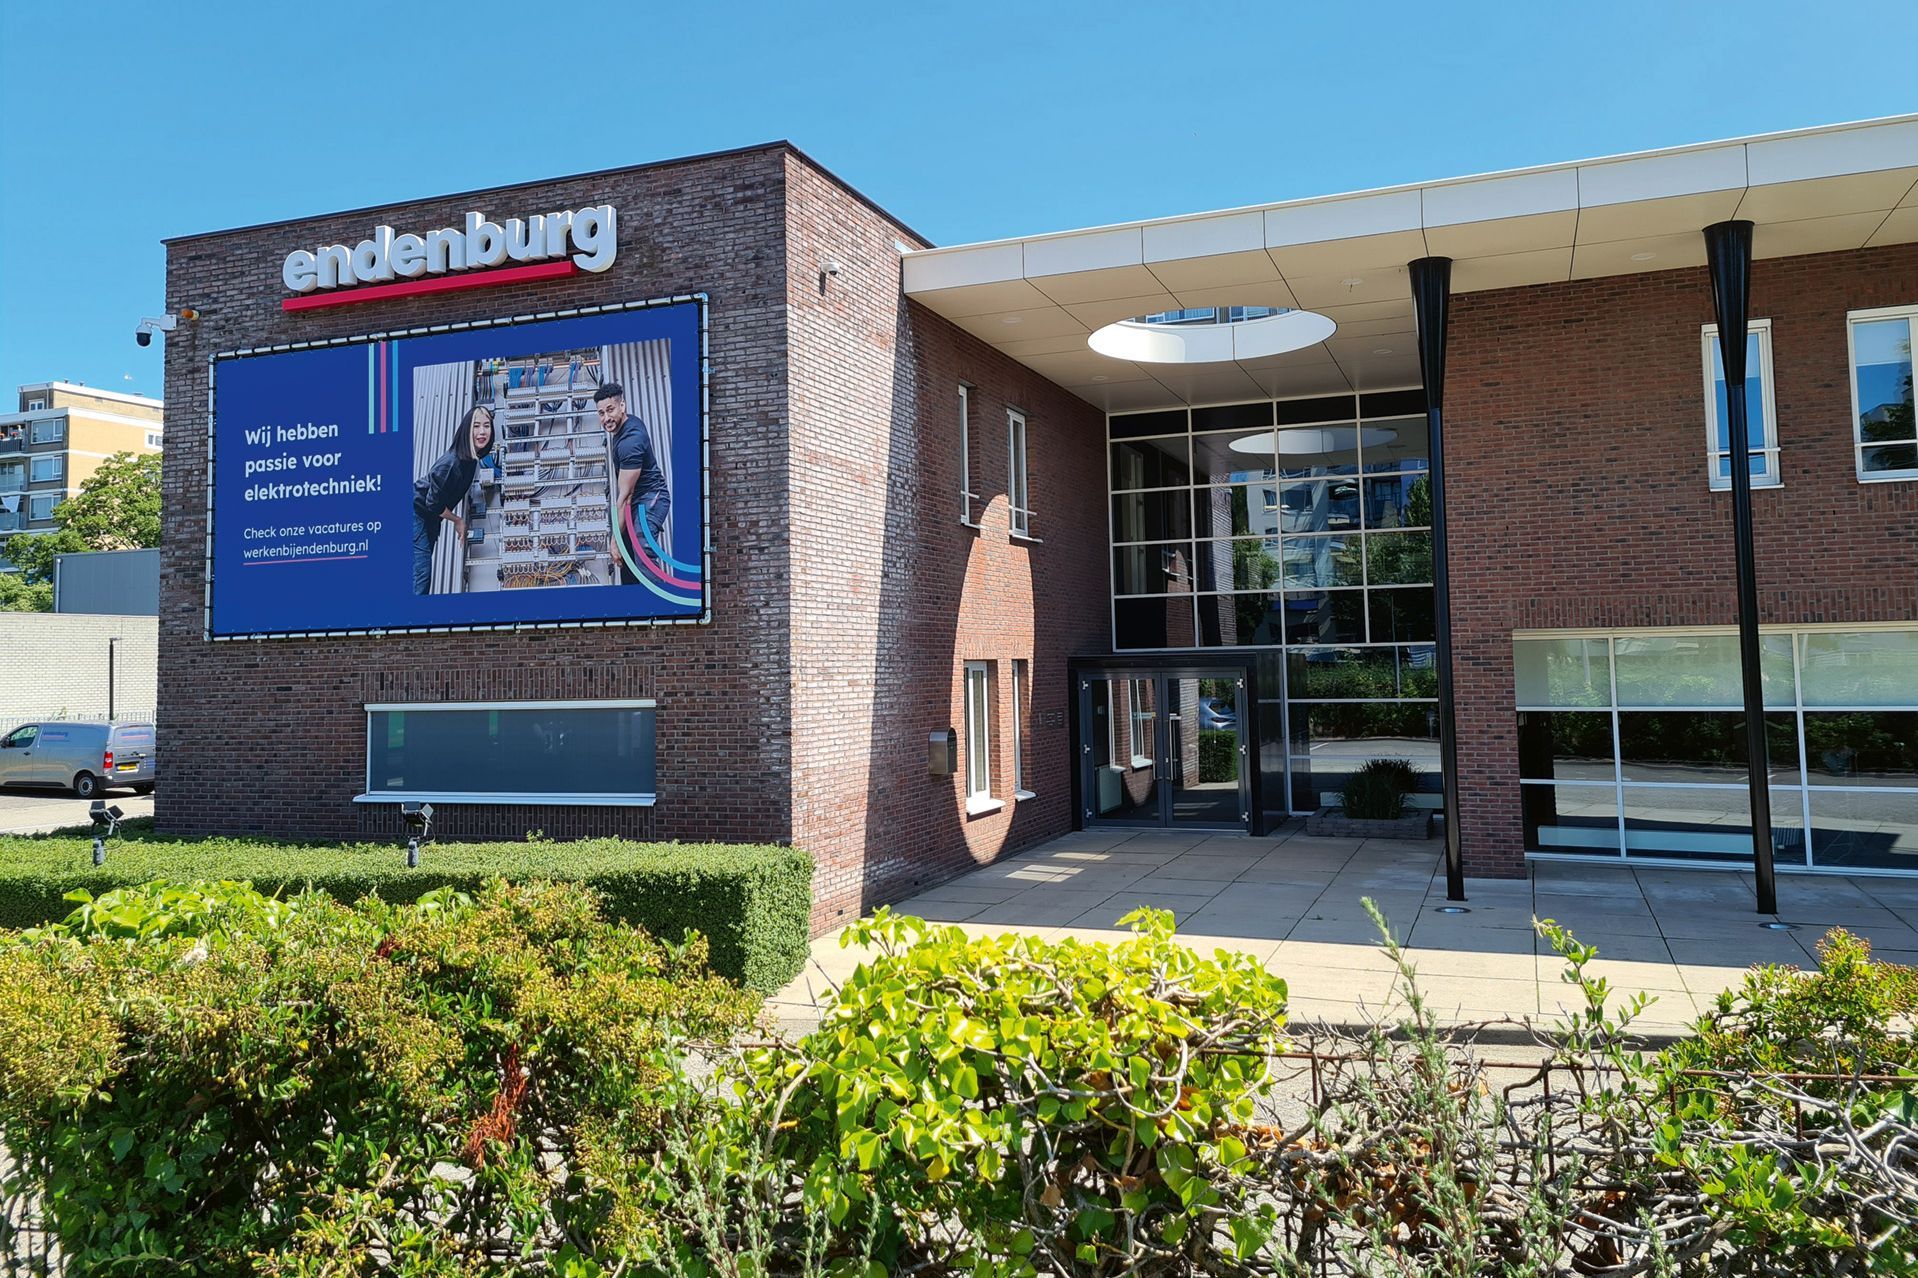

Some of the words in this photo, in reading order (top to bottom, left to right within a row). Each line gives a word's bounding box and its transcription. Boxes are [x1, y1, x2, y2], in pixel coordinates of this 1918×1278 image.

[282, 204, 617, 293] endenburg
[245, 426, 271, 447] Wij
[277, 423, 338, 442] hebben
[245, 452, 297, 478] passie
[302, 452, 342, 468] voor
[244, 474, 382, 501] elektrotechniek!
[243, 526, 276, 539] Check
[279, 525, 305, 537] onze
[308, 521, 363, 535] vacatures
[367, 521, 382, 533] op
[243, 539, 369, 559] werkenbijendenburg.nl
